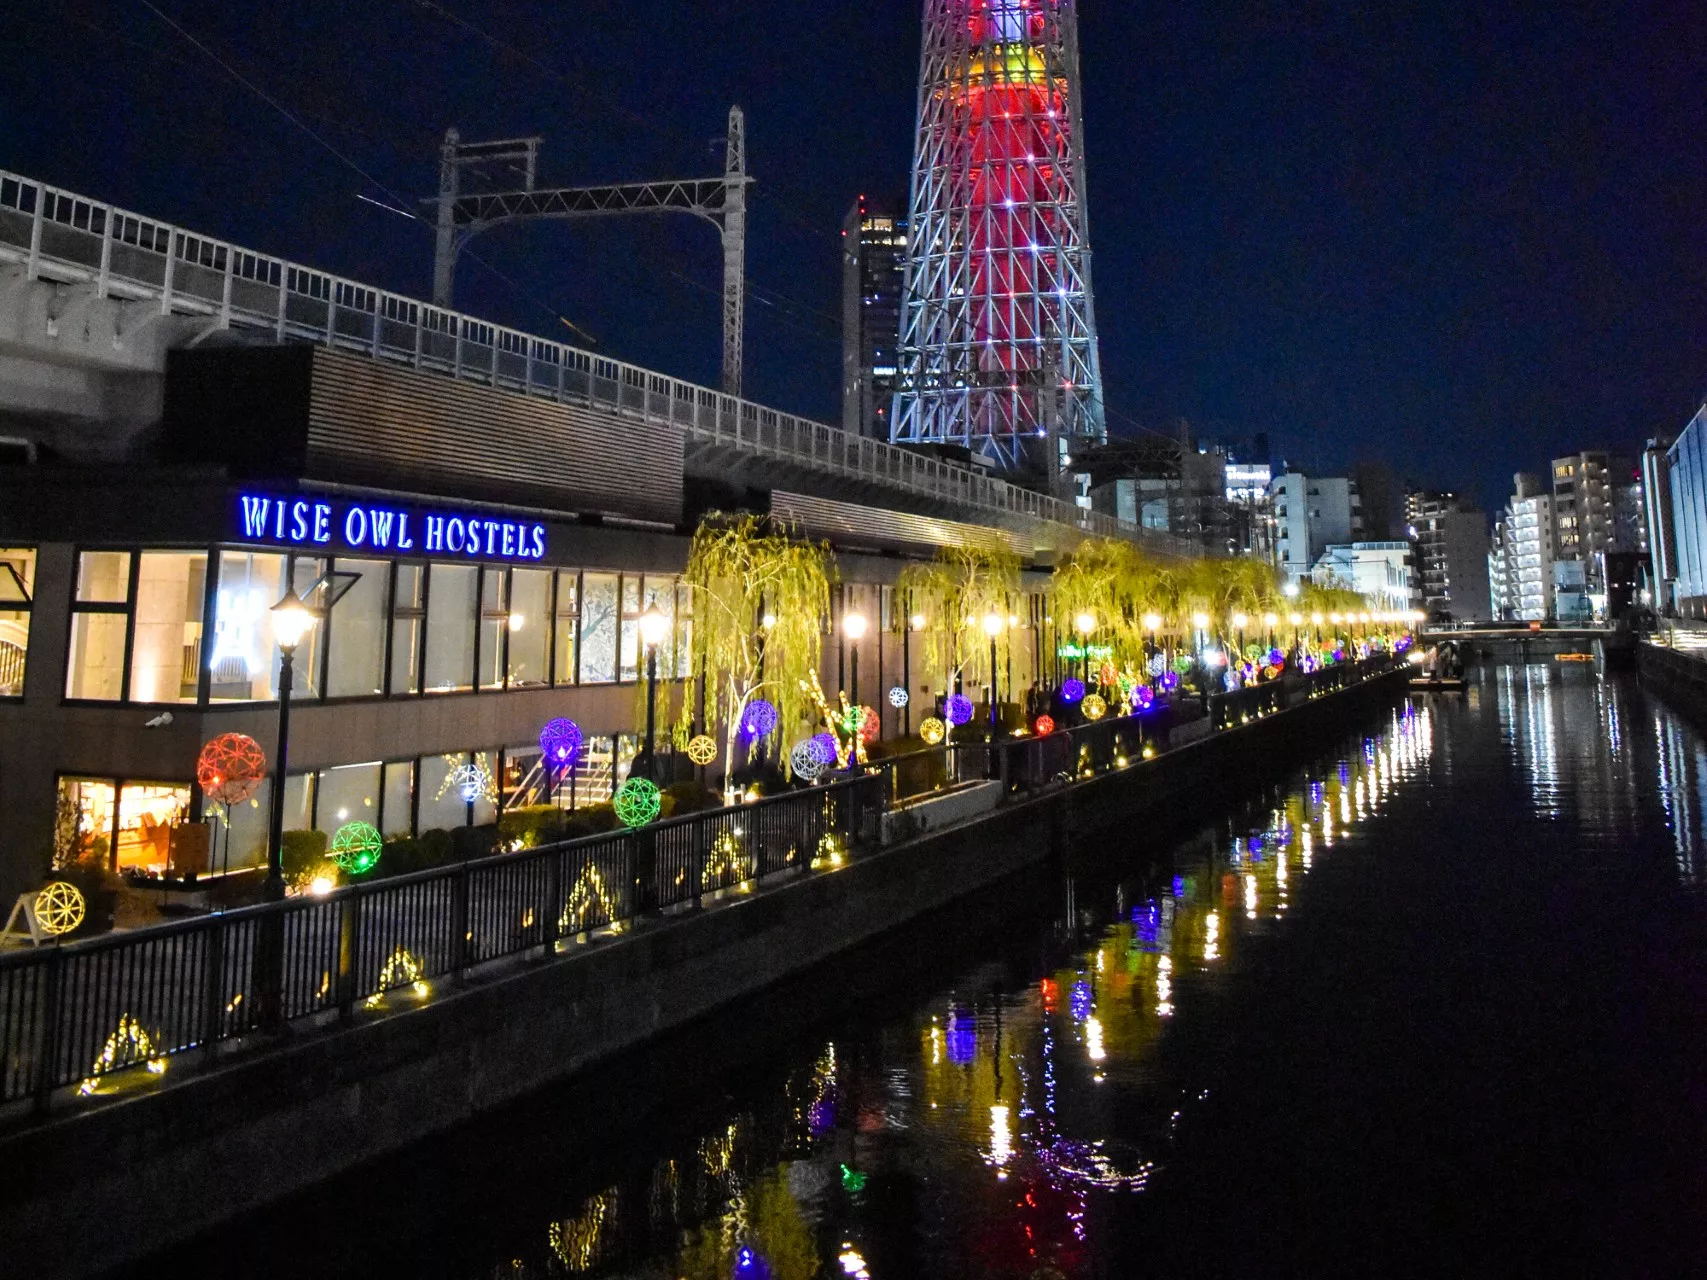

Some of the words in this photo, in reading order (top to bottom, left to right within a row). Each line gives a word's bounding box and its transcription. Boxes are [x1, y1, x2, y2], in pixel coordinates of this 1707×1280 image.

[241, 496, 331, 542] WISE
[345, 507, 413, 549] OWL
[426, 516, 546, 558] HOSTELS
